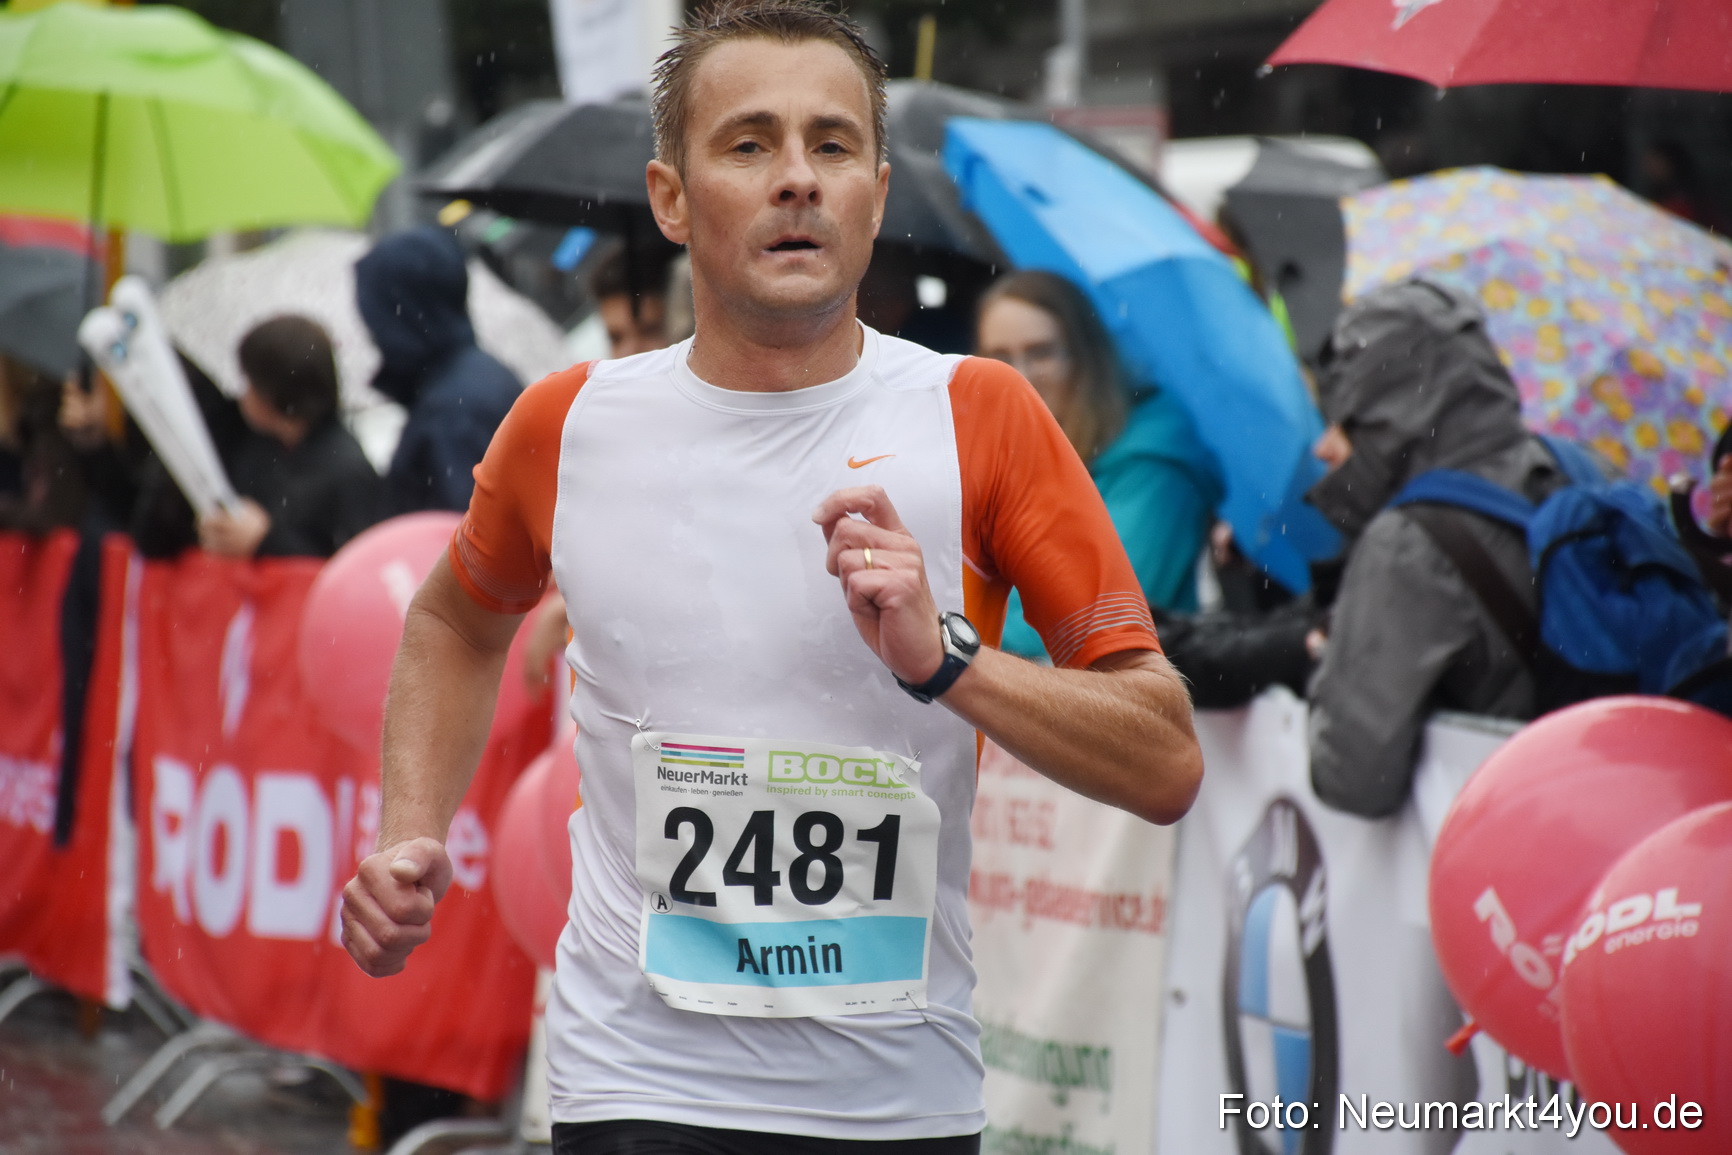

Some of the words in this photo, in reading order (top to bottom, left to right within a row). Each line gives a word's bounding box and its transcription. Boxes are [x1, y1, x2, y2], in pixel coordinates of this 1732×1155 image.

[657, 766, 748, 786] NeuerMarkt
[768, 751, 909, 788] BOCK
[660, 785, 688, 794] einkaufen
[691, 787, 708, 795] leben
[712, 789, 744, 797] genießen
[767, 784, 812, 796] inspired
[815, 786, 827, 798] by
[831, 788, 864, 797] smart
[867, 790, 916, 801] concepts
[664, 806, 901, 907] 2481
[657, 894, 668, 910] A
[736, 936, 843, 976] Armin
